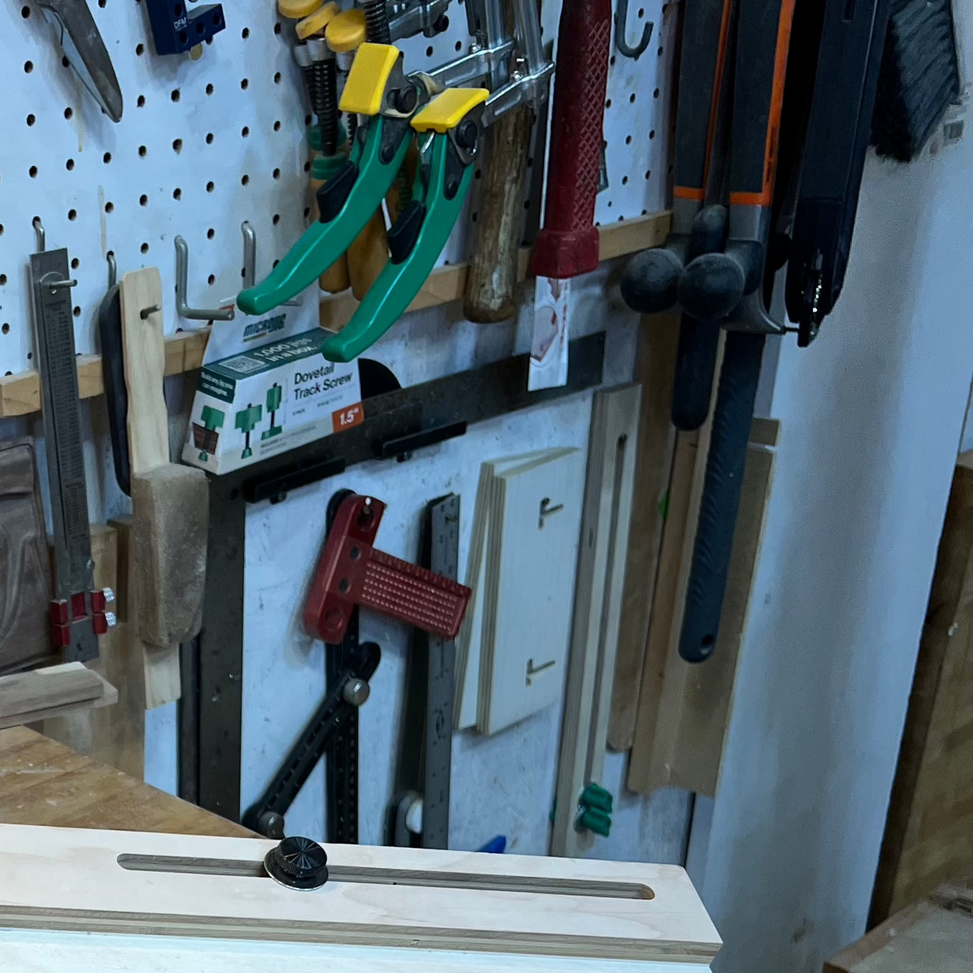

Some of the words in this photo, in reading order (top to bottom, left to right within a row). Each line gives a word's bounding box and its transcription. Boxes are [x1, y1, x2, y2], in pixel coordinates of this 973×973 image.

[293, 382, 321, 401] Track
[322, 372, 354, 391] Screw
[294, 362, 335, 386] Dovetail
